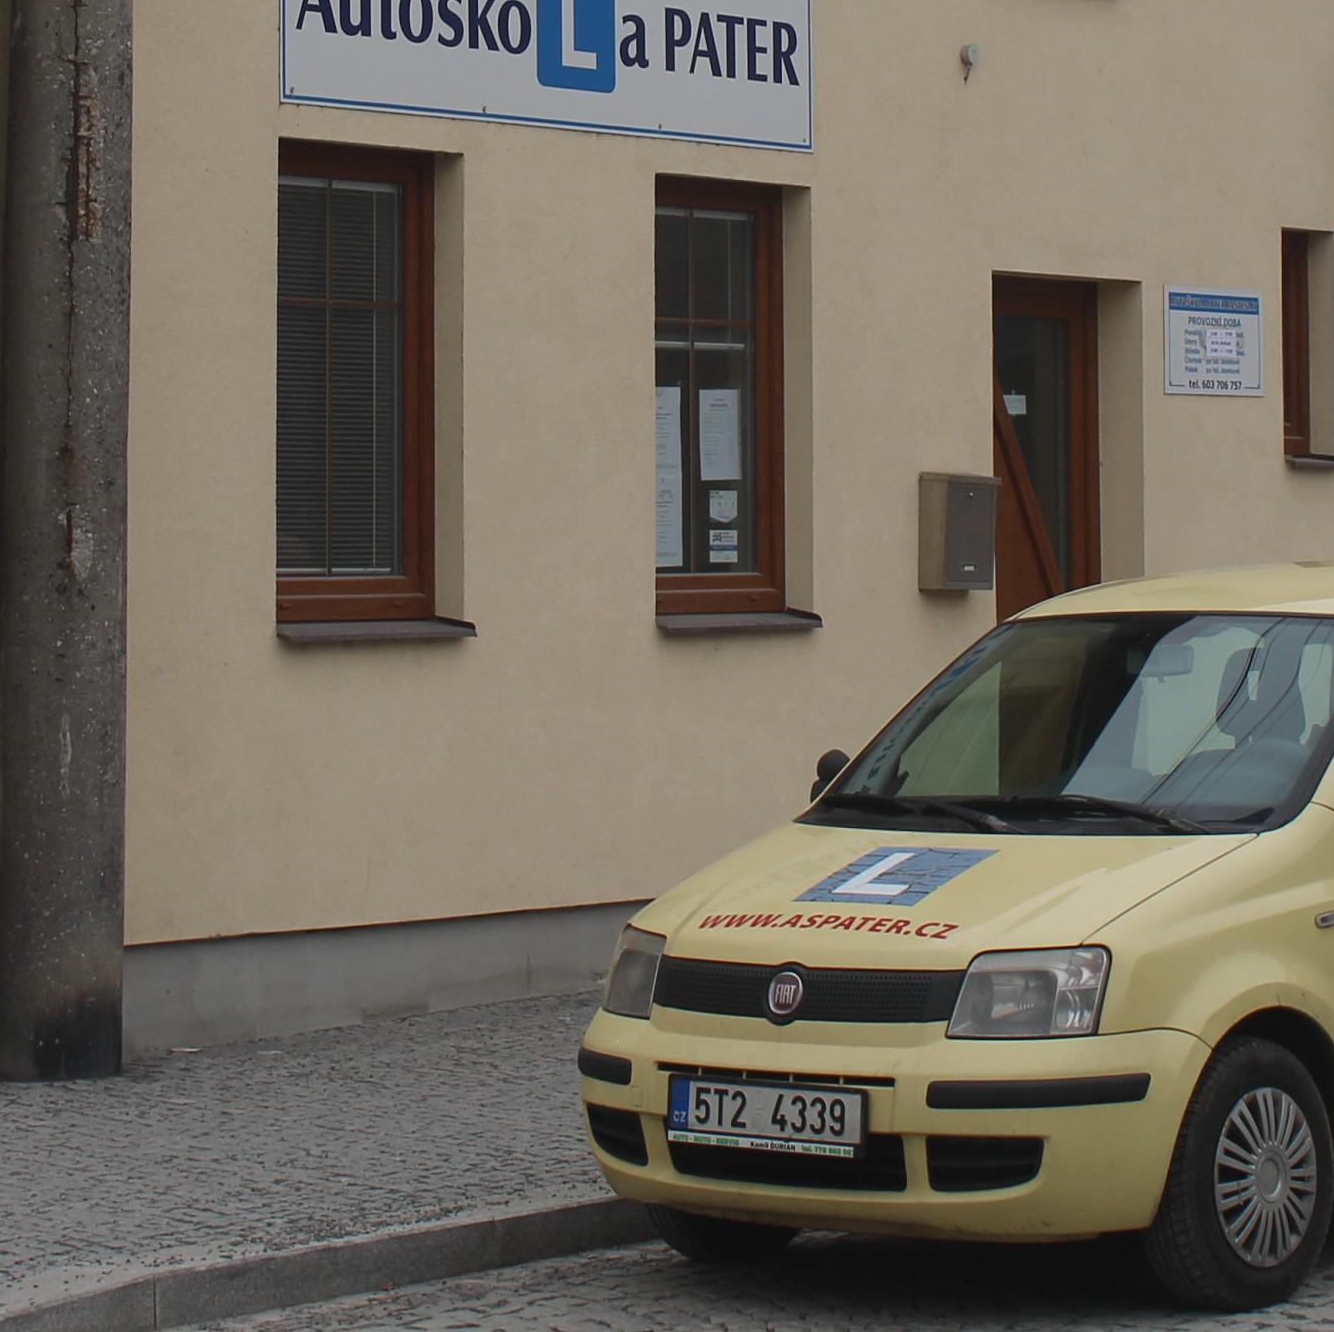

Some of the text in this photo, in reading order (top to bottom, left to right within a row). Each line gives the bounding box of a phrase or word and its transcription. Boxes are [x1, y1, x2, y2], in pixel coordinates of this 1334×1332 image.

[664, 6, 800, 86] PATER
[1187, 315, 1241, 327] PROVOZNÍ DOBA
[1188, 379, 1242, 390] tel. 603 706 757
[832, 852, 916, 896] L
[698, 913, 960, 940] WWW.ASPATER.CZ
[774, 983, 797, 1004] FIAT
[673, 1110, 687, 1123] CZ
[694, 1086, 847, 1137] 5T2 4339
